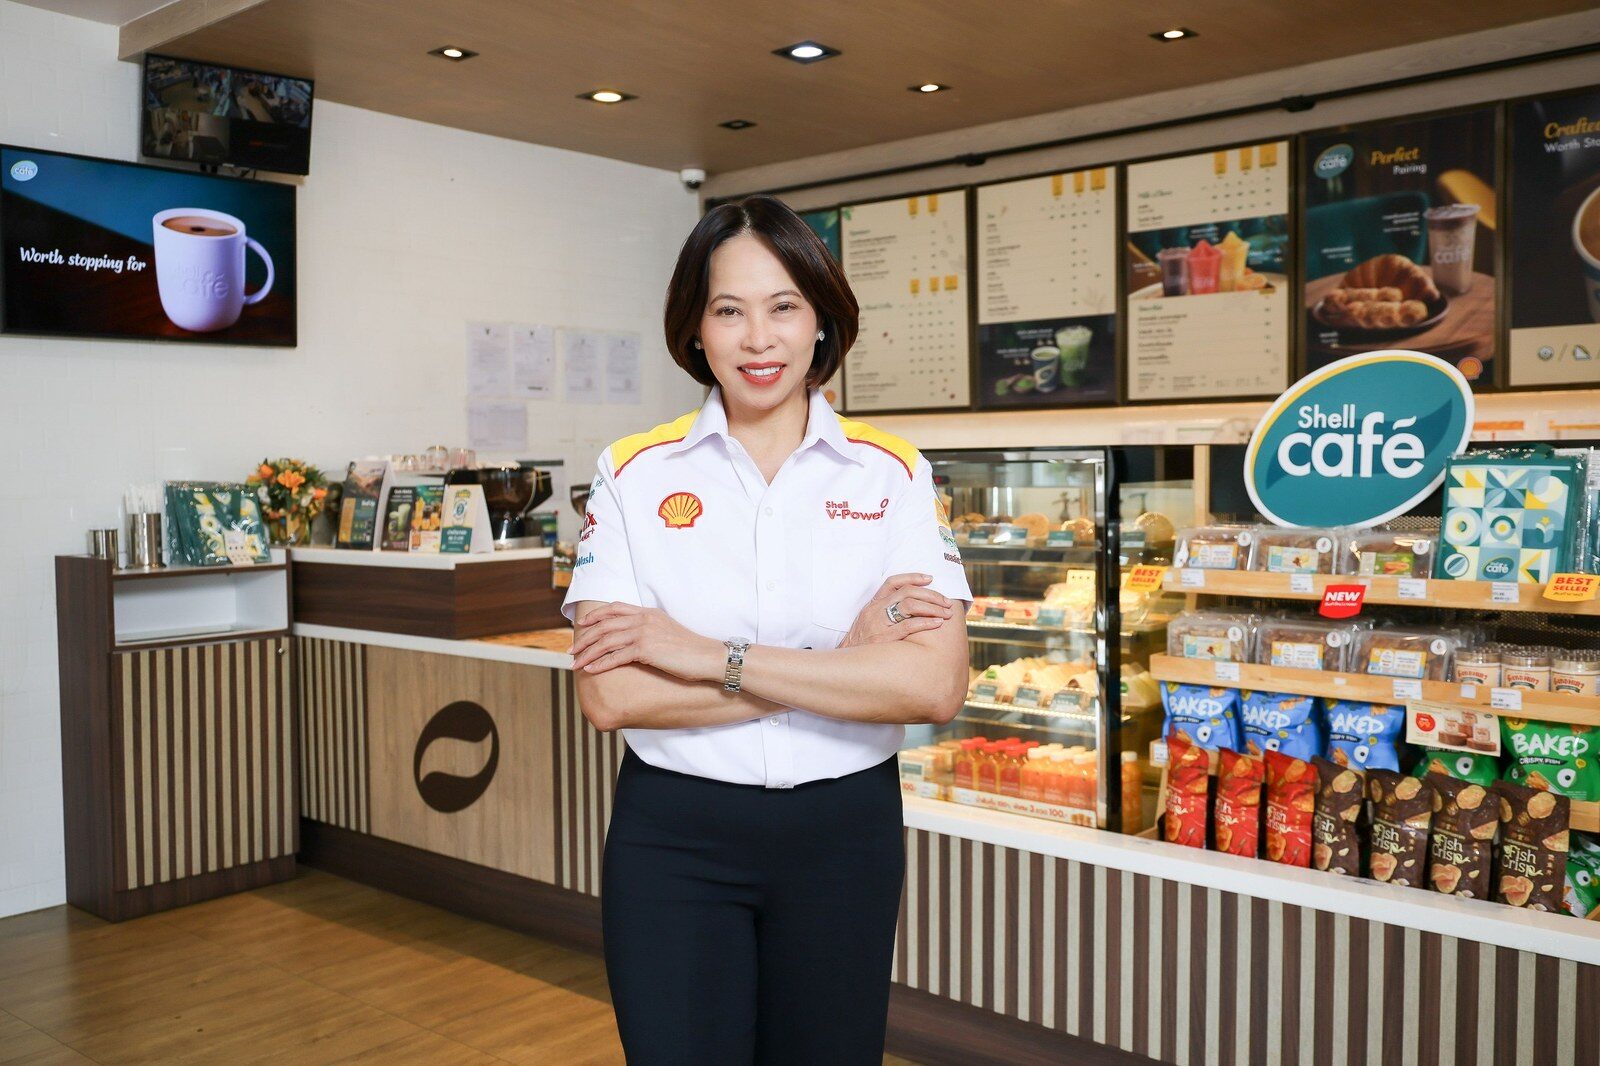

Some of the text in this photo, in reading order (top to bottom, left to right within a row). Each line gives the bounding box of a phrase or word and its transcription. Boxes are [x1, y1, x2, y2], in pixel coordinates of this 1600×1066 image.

[1544, 138, 1580, 152] Worth
[1371, 147, 1420, 166] Perfect
[1393, 164, 1427, 175] Pairing
[20, 247, 147, 274] Worth stopping for
[1298, 404, 1355, 429] Shell
[1277, 411, 1425, 479] café
[825, 501, 849, 509] Shell
[825, 509, 886, 521] V-Power
[1135, 569, 1161, 577] BEST
[1555, 577, 1594, 586] BEST
[1324, 591, 1361, 602] NEW
[1552, 585, 1589, 593] SELLER
[1168, 695, 1223, 718] BAKED
[1329, 713, 1385, 735] AKED
[1511, 732, 1589, 758] BAKED
[1373, 822, 1400, 845] Fish
[1433, 833, 1463, 853] Fish
[1503, 844, 1536, 865] Fish
[1502, 854, 1544, 878] Crisp
